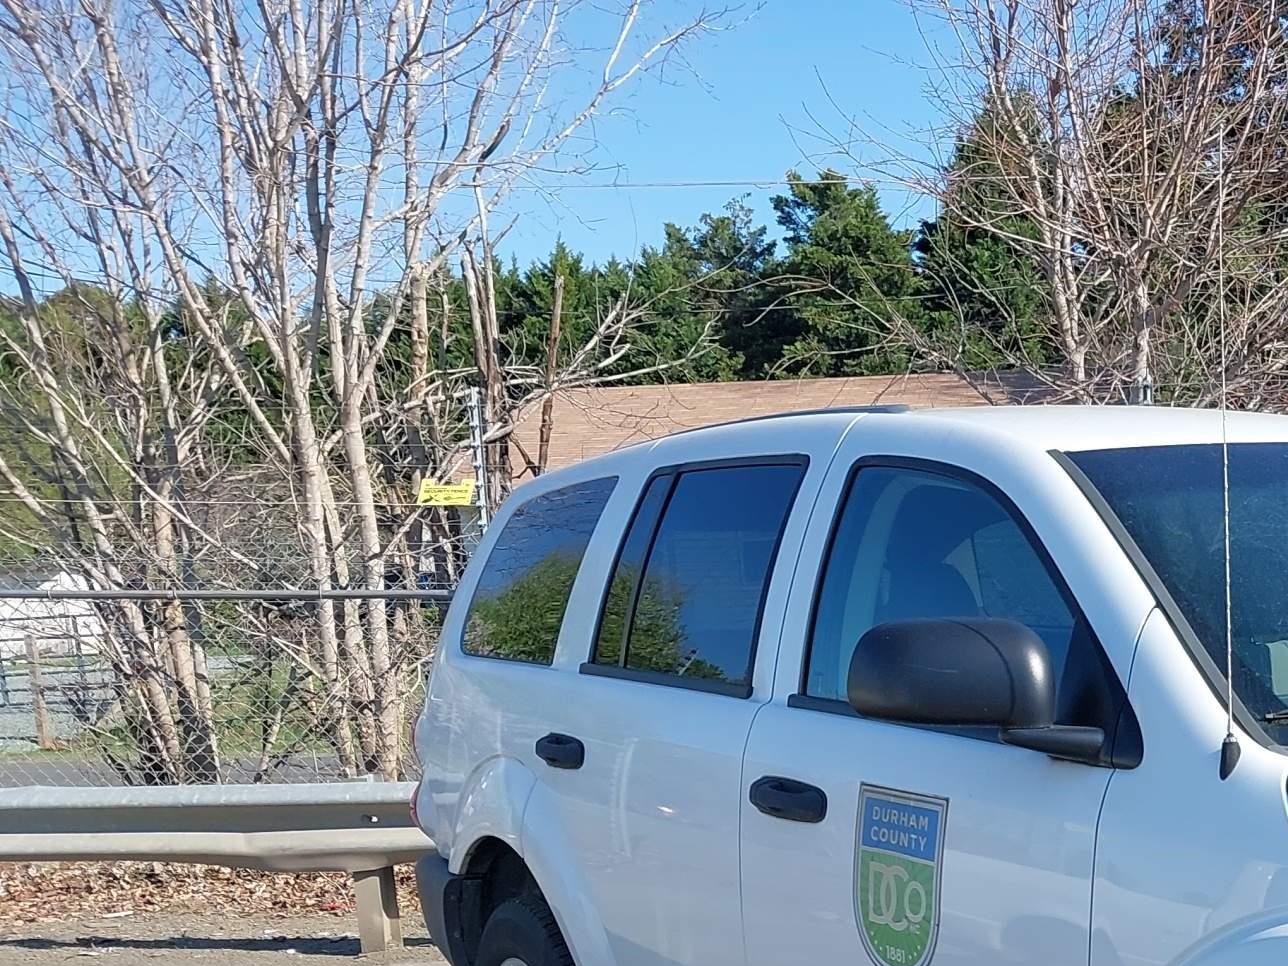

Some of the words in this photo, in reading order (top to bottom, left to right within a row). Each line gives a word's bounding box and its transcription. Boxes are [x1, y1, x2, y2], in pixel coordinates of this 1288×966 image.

[872, 806, 929, 831] DURHAM
[870, 826, 928, 852] COUNTY
[885, 945, 906, 963] 1881
